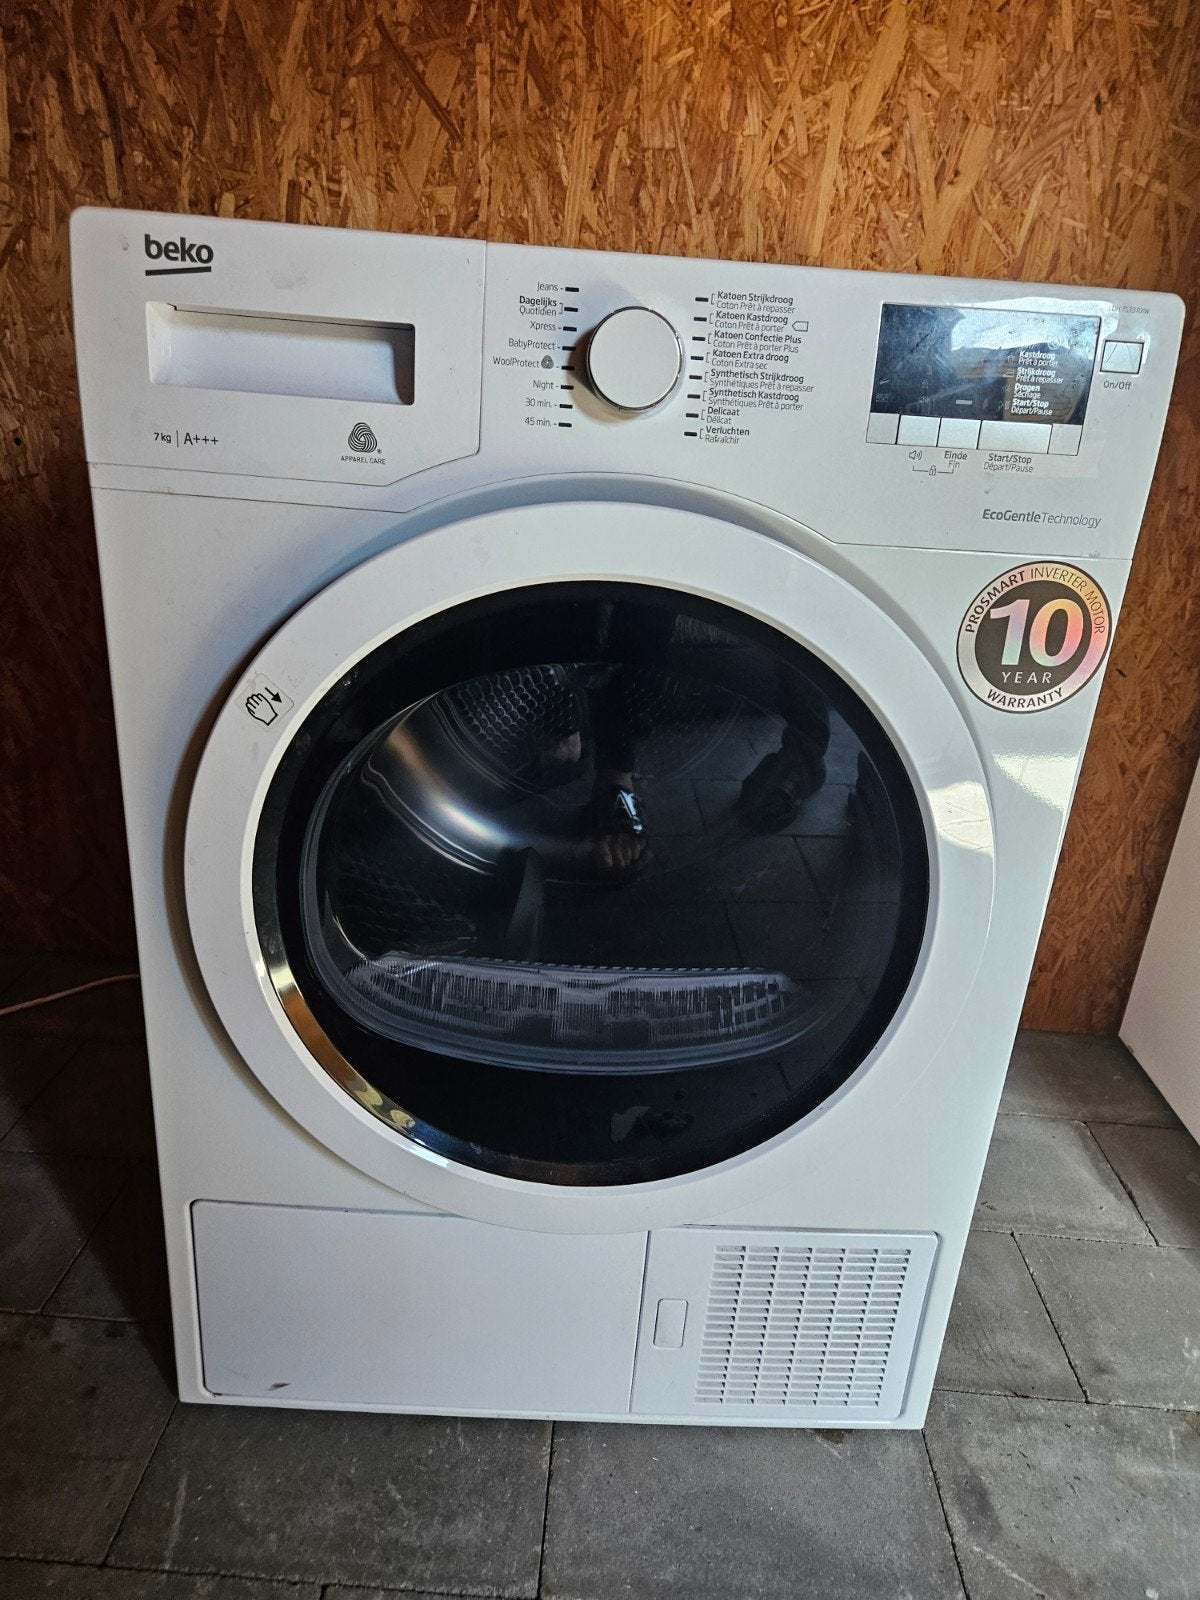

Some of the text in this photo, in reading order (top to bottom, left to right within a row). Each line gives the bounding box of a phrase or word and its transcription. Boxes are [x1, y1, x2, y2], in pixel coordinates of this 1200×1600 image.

[144, 234, 214, 264] beko
[537, 282, 558, 292] Jeans
[519, 295, 557, 307] Dagelijks
[718, 291, 793, 306] Katoen Strijkdroog
[519, 306, 556, 316] Quotidien
[717, 301, 738, 310] Coton
[740, 302, 756, 311] Prêt
[763, 306, 795, 314] repasser
[716, 311, 788, 325] Katoen Kastdroog
[529, 321, 556, 331] Xpress
[715, 320, 736, 329] Coton
[738, 321, 753, 330] Prêt
[761, 324, 784, 332] porter
[714, 330, 802, 343] Katoen Confectie Plus
[508, 338, 555, 350] BabyProtect
[713, 339, 735, 348] Coton
[737, 340, 752, 349] Prêt
[759, 343, 782, 352] porter
[784, 344, 799, 353] Plus
[713, 349, 789, 363] Katoen Extra droog
[1020, 351, 1055, 361] Kastdroog
[493, 356, 539, 368] WoolProtect
[712, 358, 733, 367] Coton
[735, 359, 754, 368] Extra
[711, 369, 804, 384] Synthetisch Strijkdroog
[1017, 367, 1056, 377] Strijkdroog
[533, 380, 554, 391] Night
[710, 378, 758, 389] Synthétiques
[760, 379, 775, 389] Prêt
[782, 384, 814, 392] repasser
[1015, 383, 1040, 392] Drogen
[1103, 380, 1132, 390] On/Off
[709, 388, 799, 402] Synthetisch Kastdroog
[525, 399, 536, 407] 30
[709, 397, 756, 408] Synthétiques
[758, 399, 774, 408] Prêt
[781, 403, 804, 411] porter
[1012, 399, 1049, 408] Start/Stop
[707, 407, 740, 416] Delicaat
[1011, 407, 1052, 415] Départ/Pause
[524, 417, 535, 426] 45
[707, 415, 731, 425] Délicat
[706, 426, 750, 436] Verluchten
[183, 432, 219, 445] A+++
[340, 455, 386, 465] APPAREL CARE
[944, 450, 968, 460] Einde
[988, 453, 1032, 464] Start/Stop
[948, 460, 960, 468] Fin
[983, 462, 1033, 473] Départ/Pause
[965, 567, 1106, 634] PROSMART INVERTER MOTOR
[989, 598, 1084, 667] 10
[1001, 671, 1052, 684] YEAR
[987, 687, 1064, 708] WARRANTY
